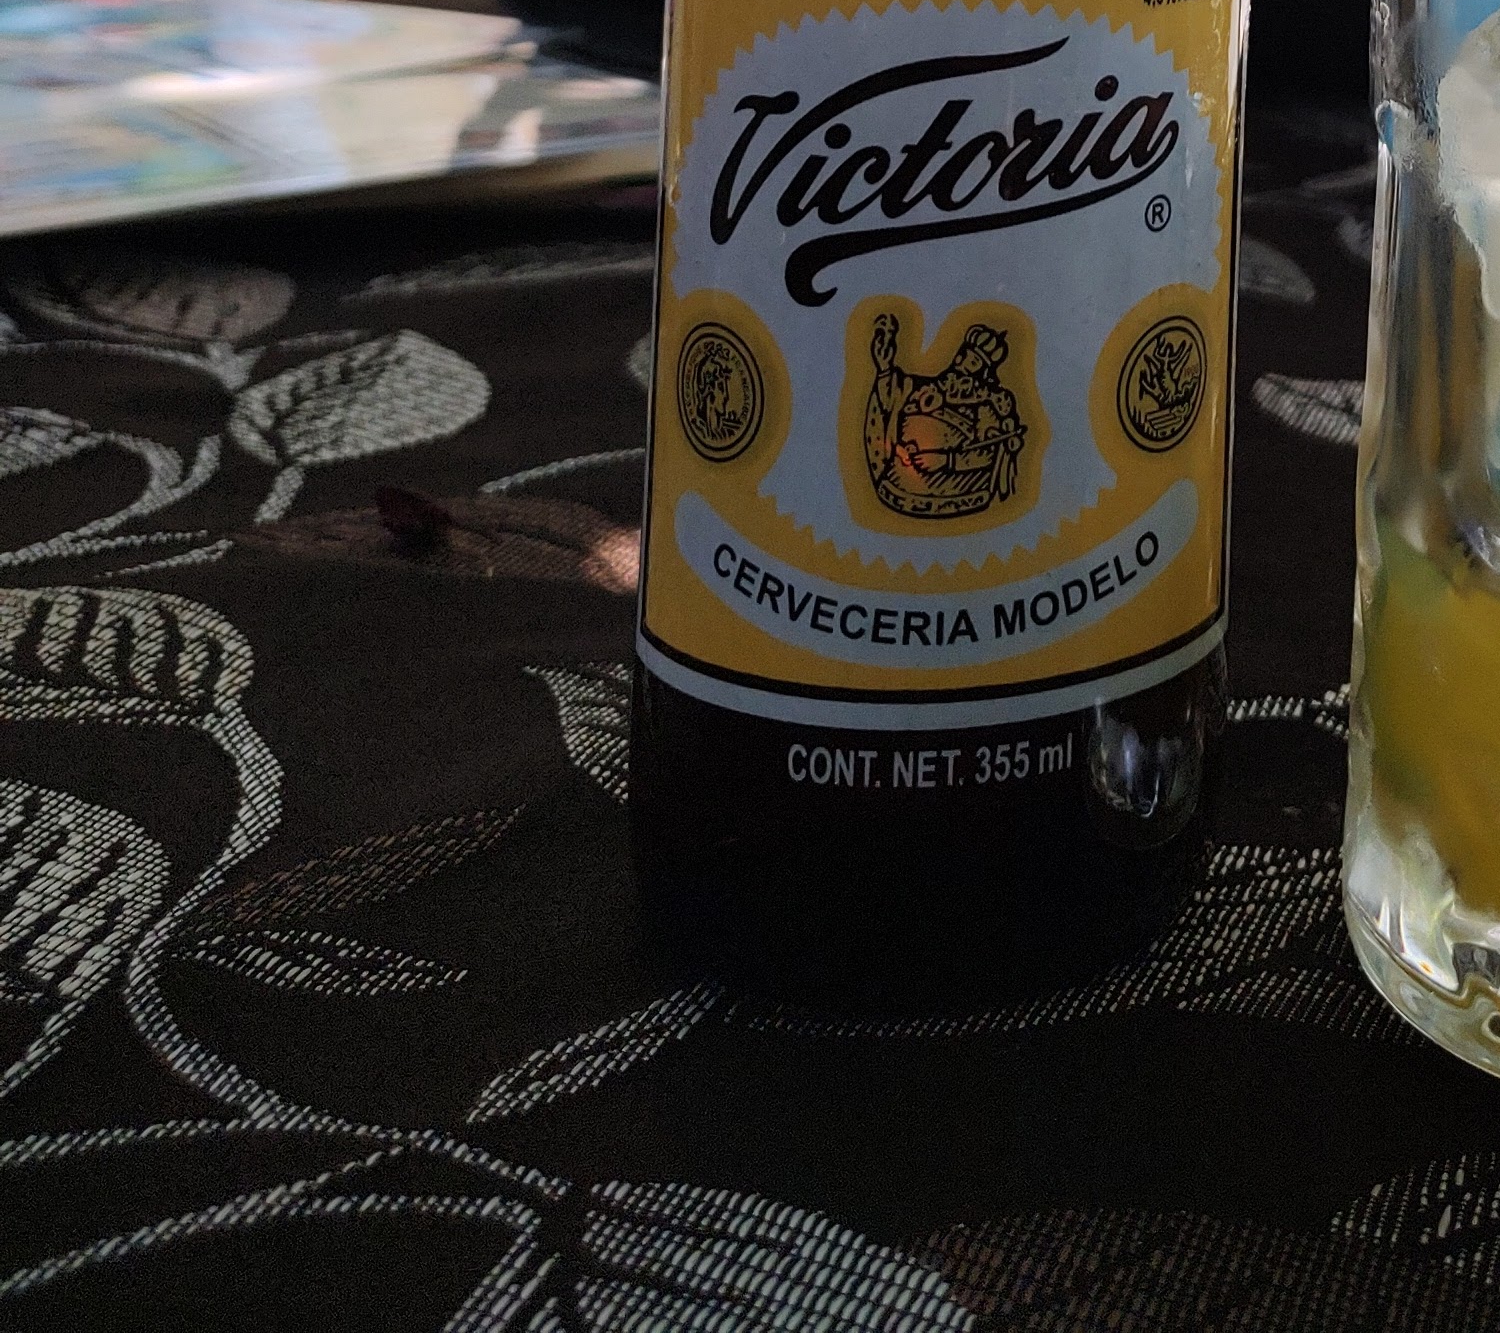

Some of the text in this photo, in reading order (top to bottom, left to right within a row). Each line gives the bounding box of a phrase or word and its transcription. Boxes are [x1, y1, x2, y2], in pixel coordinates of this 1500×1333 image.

[710, 36, 1180, 307] Victoria
[713, 531, 1160, 646] CERVECERIA MODELO
[787, 733, 1073, 788] CONT. NET. 355 ml
